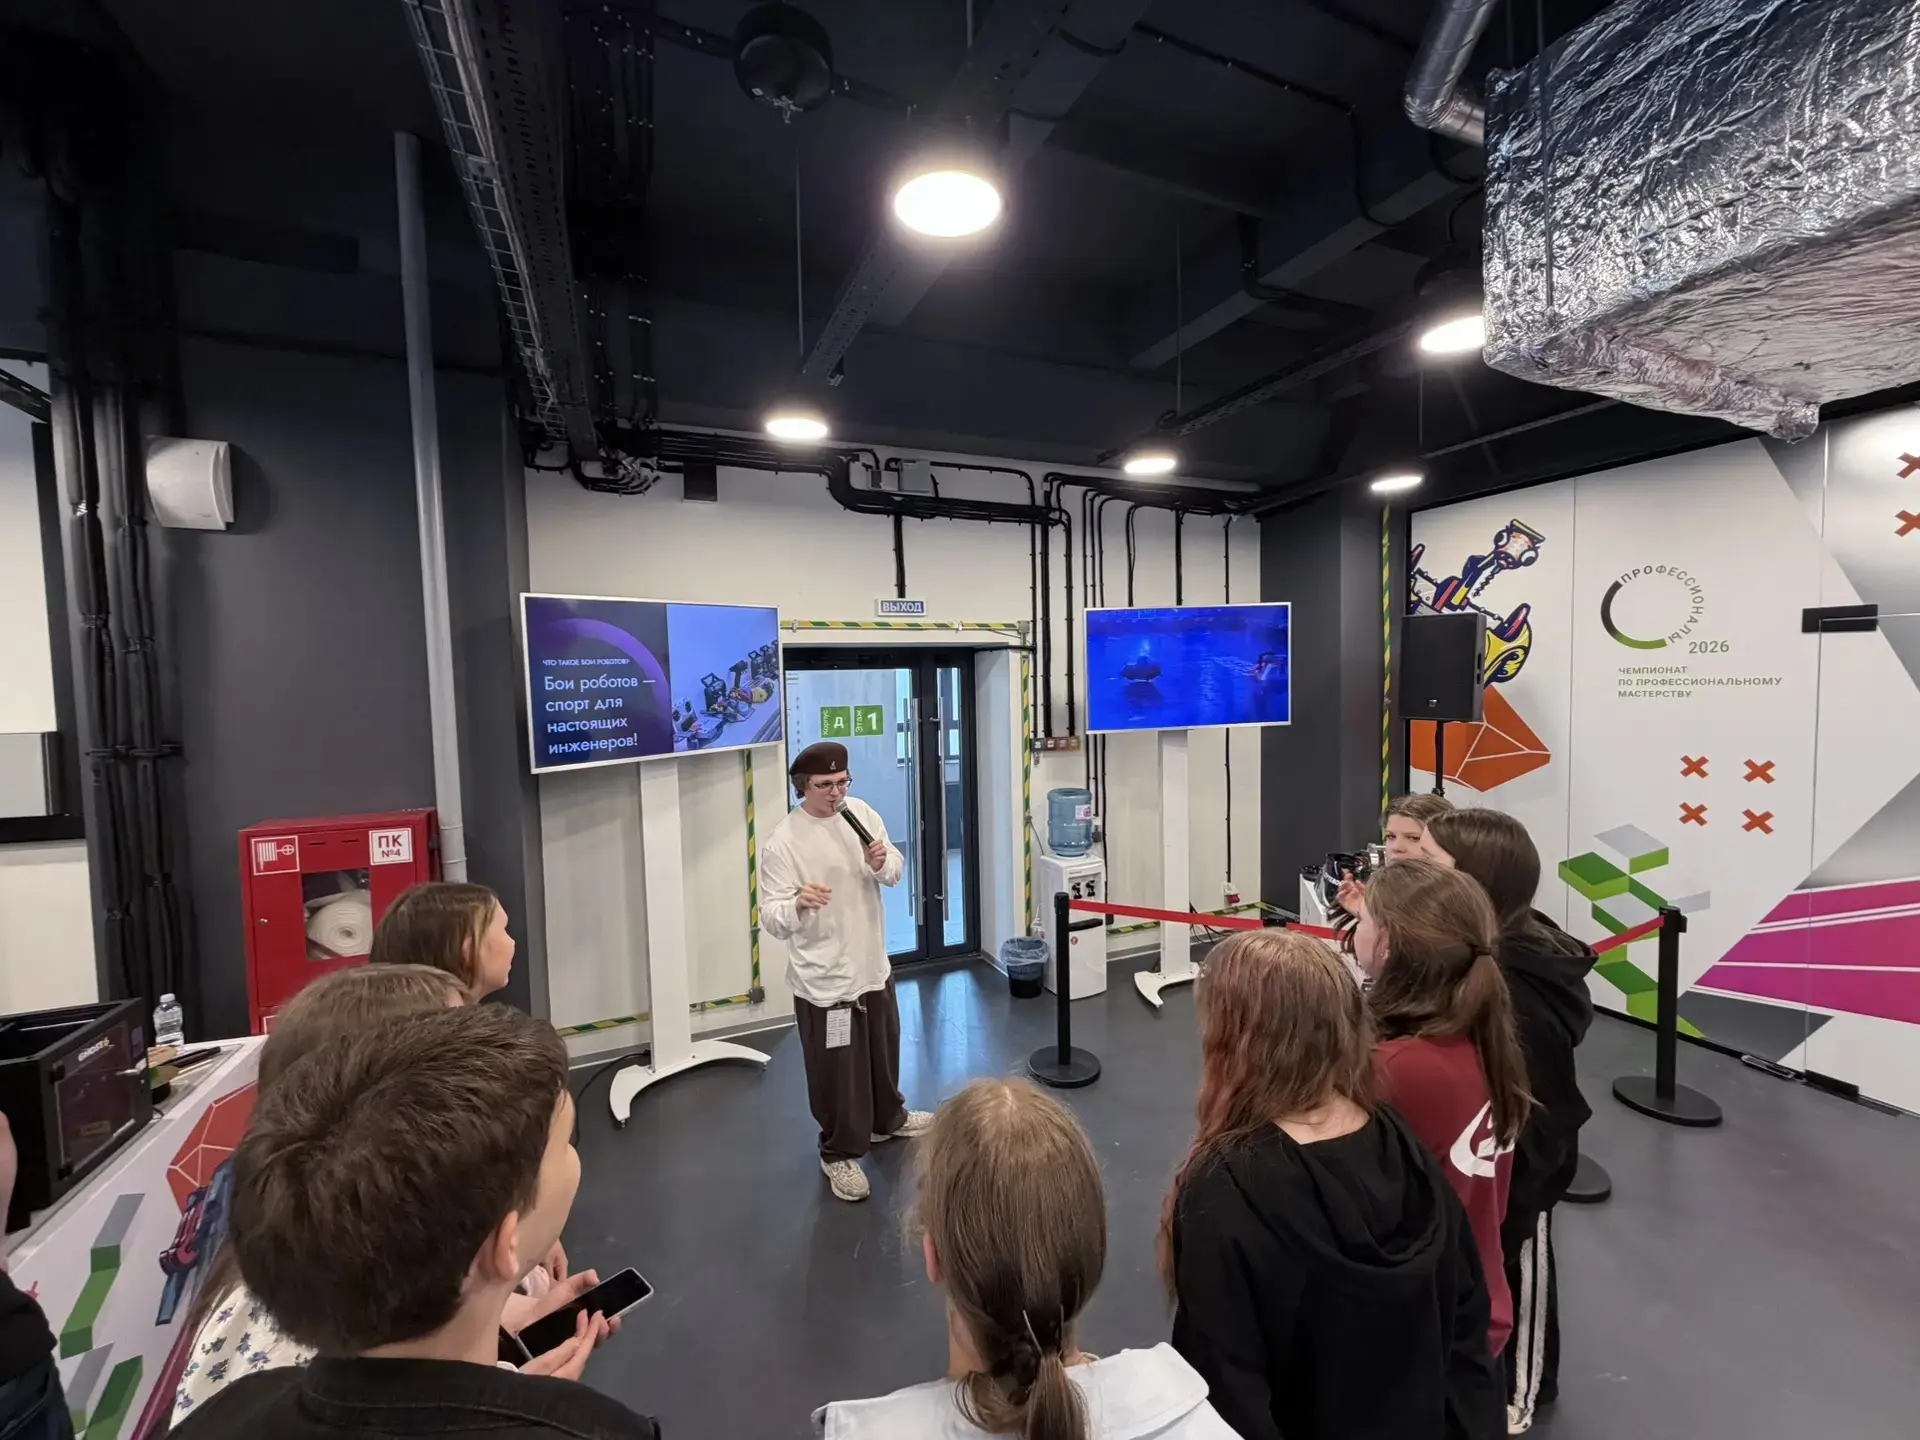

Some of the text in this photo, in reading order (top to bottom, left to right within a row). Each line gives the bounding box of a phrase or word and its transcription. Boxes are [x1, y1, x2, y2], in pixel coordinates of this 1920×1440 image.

[882, 602, 923, 613] ВЫХОД
[1620, 565, 1704, 643] ПРОФЕССИОНАЛЫ
[1688, 640, 1730, 654] 2026
[1618, 666, 1688, 675] ЧЕМПИОНАТ
[544, 676, 575, 691] Бои
[580, 673, 638, 692] роботов
[1618, 677, 1783, 686] ПО ПРОФЕССИОНАЛЬНОМУ
[1618, 690, 1692, 698] МАСТЕРСТВУ
[545, 698, 623, 714] спорт для
[547, 717, 628, 733] настоящих
[867, 712, 877, 730] 1
[548, 733, 638, 755] инженеров!
[378, 834, 403, 848] ПК
